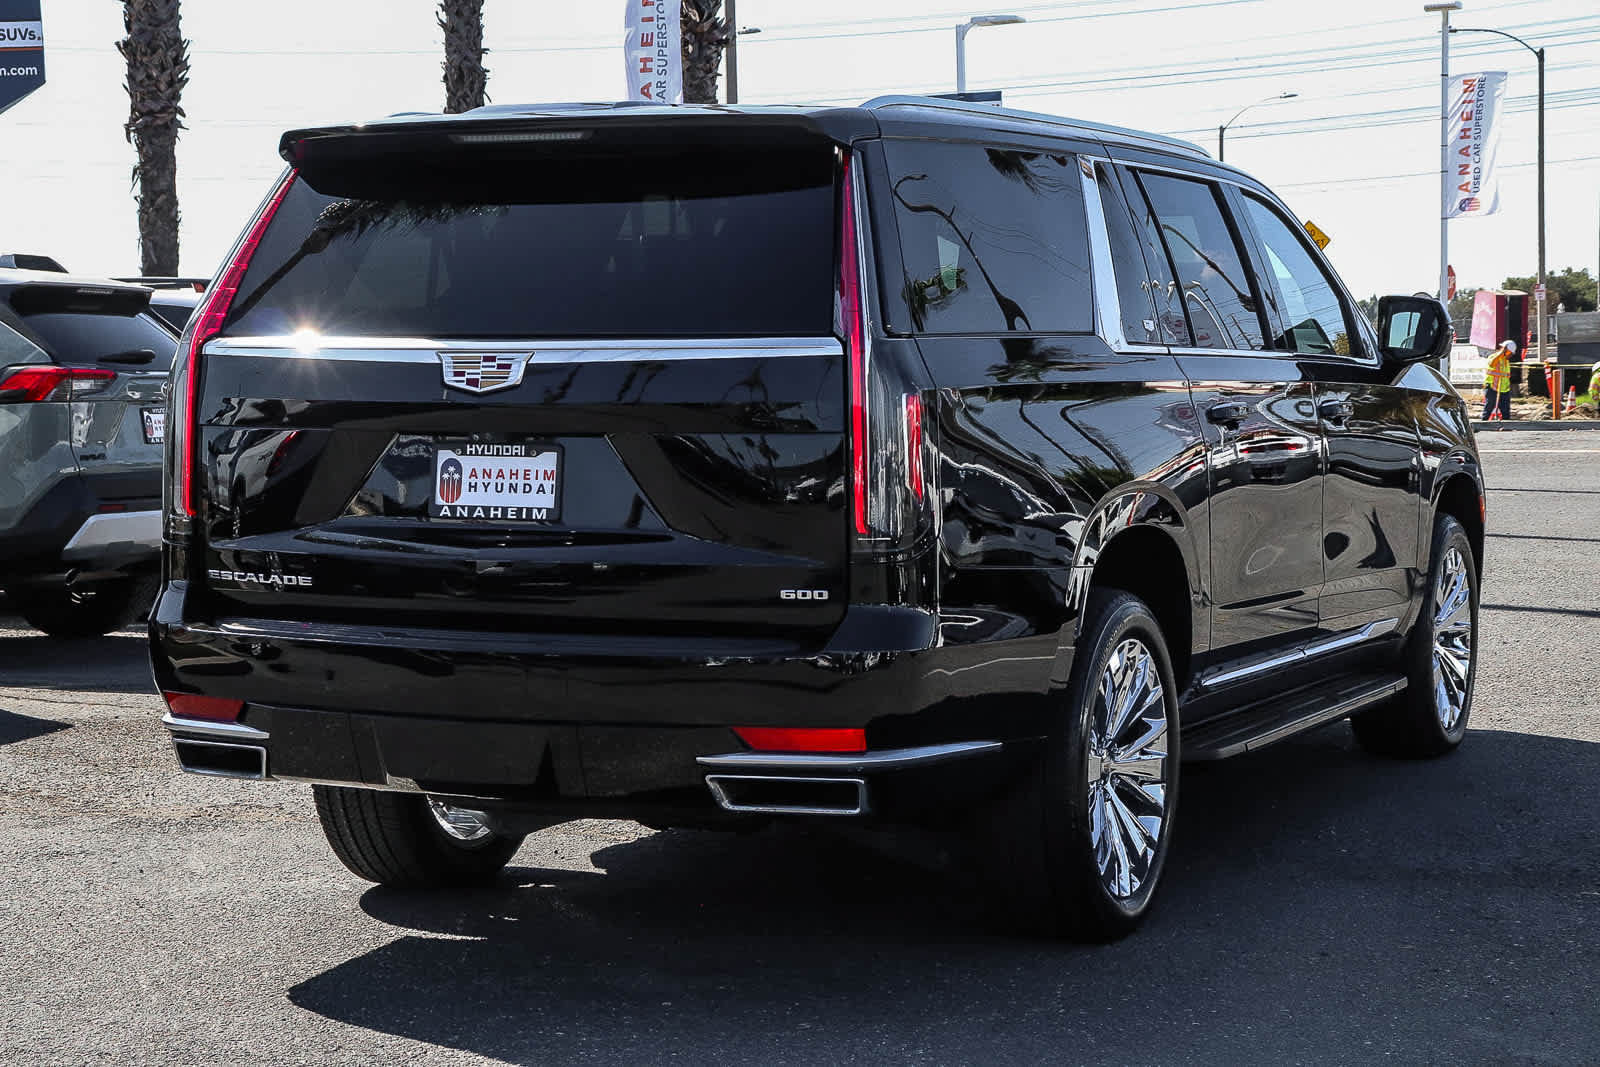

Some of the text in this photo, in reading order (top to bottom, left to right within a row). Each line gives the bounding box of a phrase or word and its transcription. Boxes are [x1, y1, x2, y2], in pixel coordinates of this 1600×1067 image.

[1457, 78, 1476, 193] ANAHEIM
[1472, 76, 1487, 193] USED CAR SUPERSTORE
[466, 444, 525, 456] HYUNDAI
[468, 467, 556, 481] ANAHEIM
[468, 481, 555, 495] HYUNDAI
[439, 505, 547, 520] ANAHEIM
[208, 569, 313, 586] ESCALADE
[780, 589, 829, 600] 600
